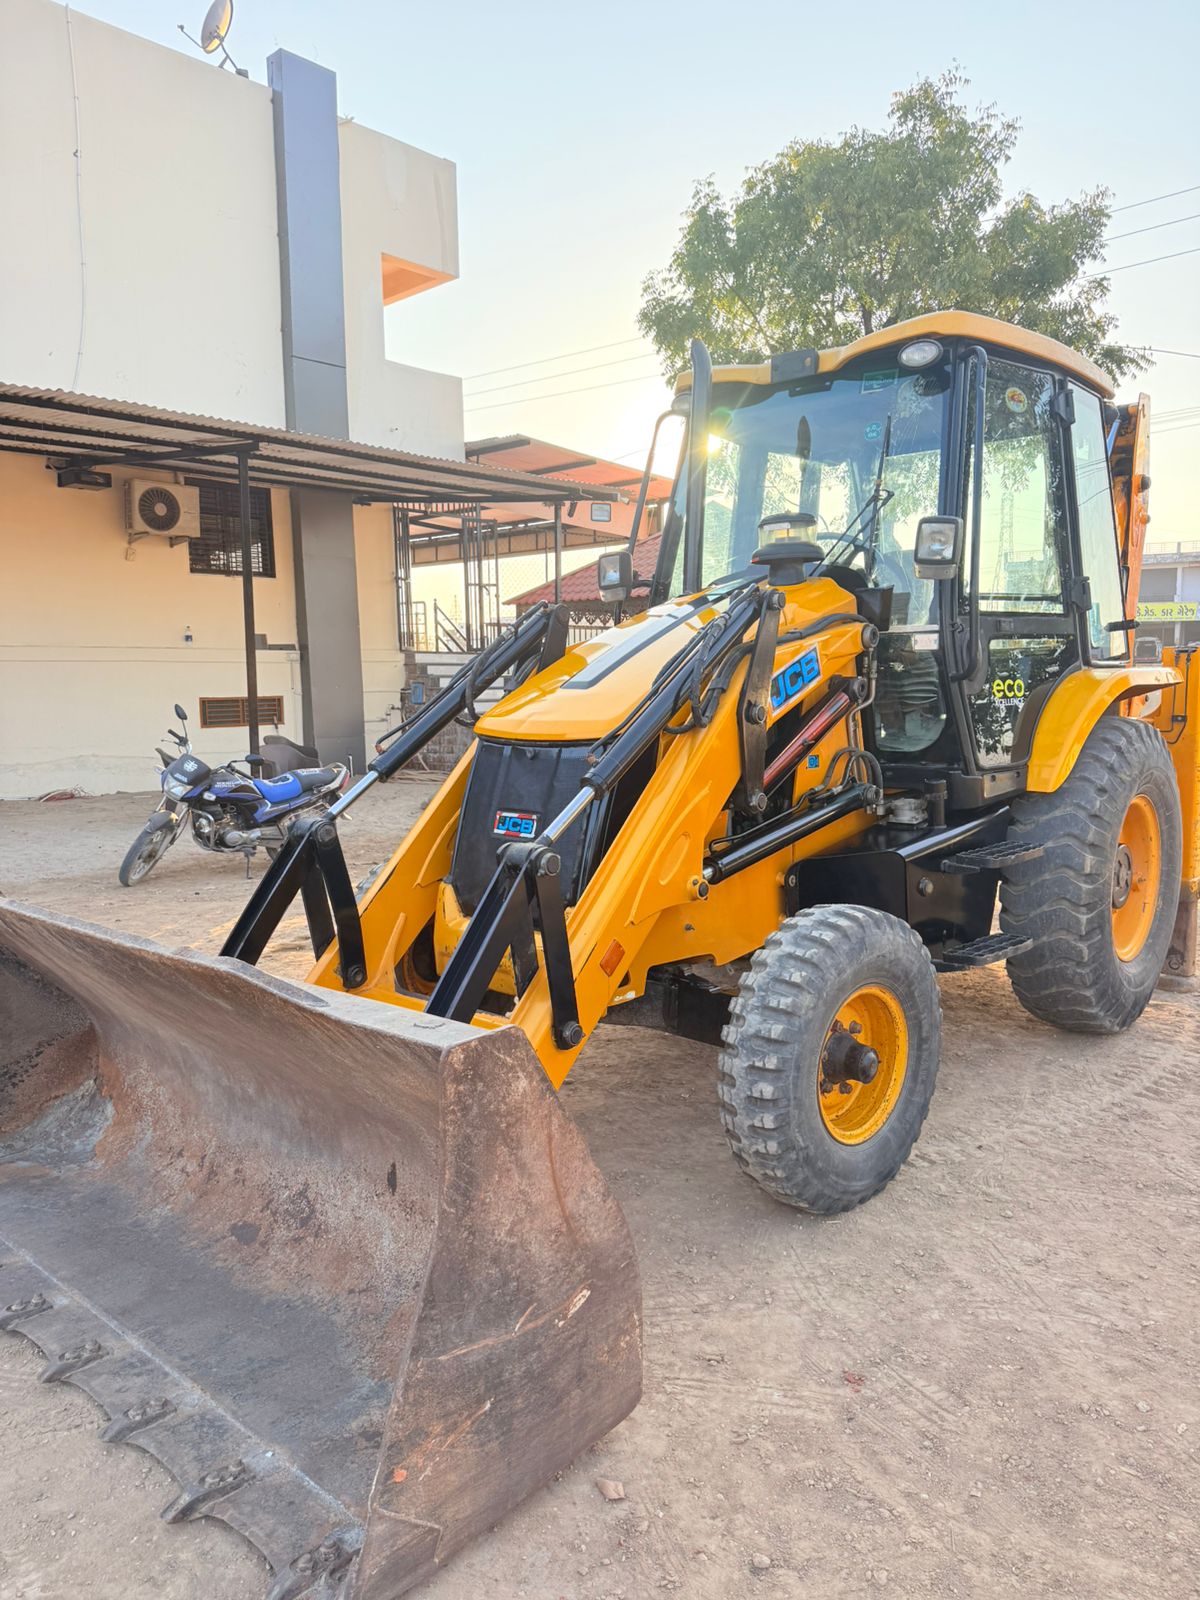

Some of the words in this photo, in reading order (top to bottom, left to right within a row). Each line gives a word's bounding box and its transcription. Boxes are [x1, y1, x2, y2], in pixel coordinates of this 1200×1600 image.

[771, 650, 820, 708] JCB
[992, 679, 1025, 697] eco
[498, 816, 534, 834] JCB
